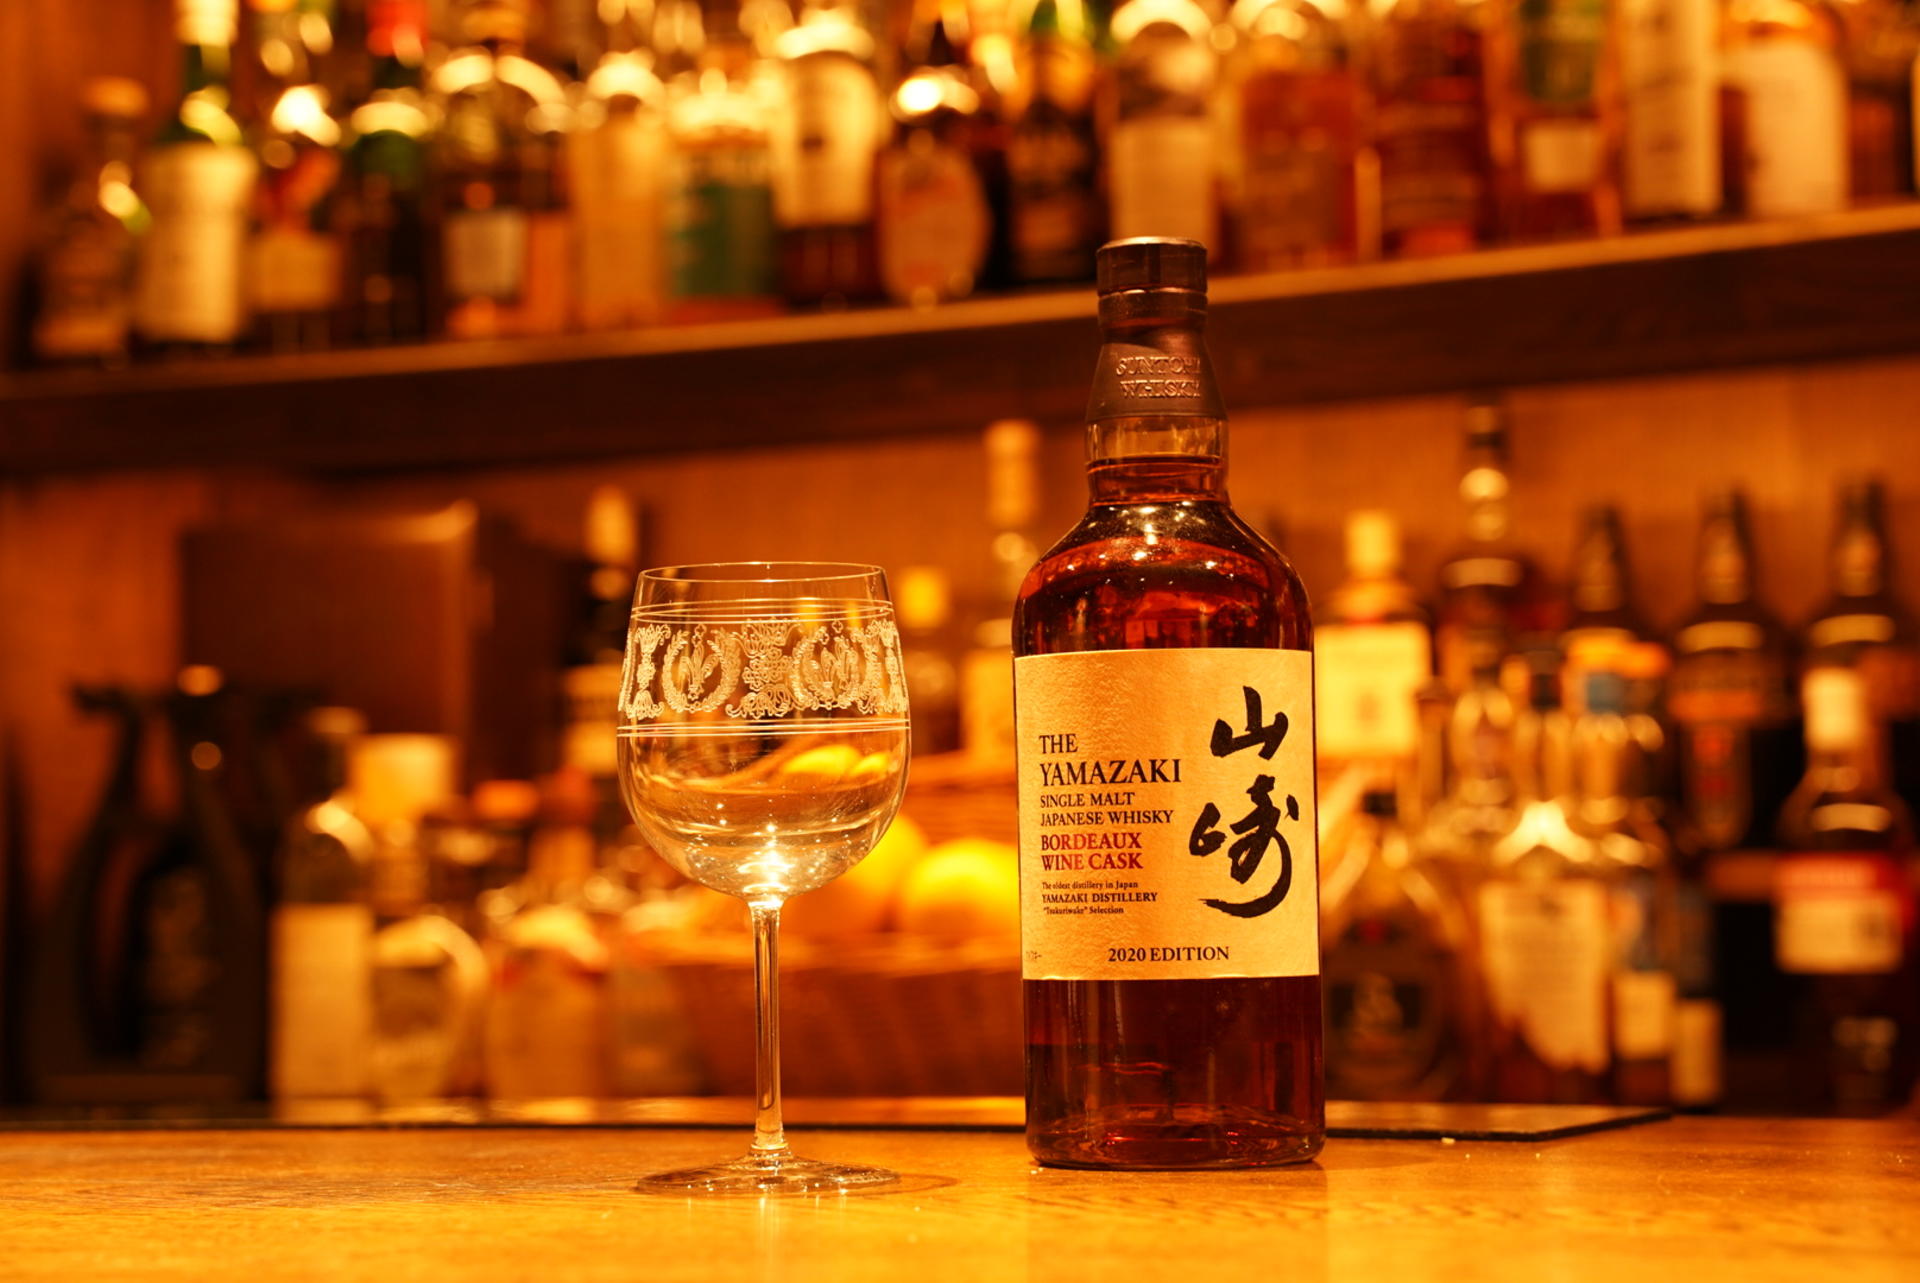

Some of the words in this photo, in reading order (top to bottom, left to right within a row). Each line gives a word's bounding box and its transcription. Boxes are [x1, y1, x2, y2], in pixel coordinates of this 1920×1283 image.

[1039, 733, 1078, 754] THE
[1040, 758, 1182, 787] YAMAZAKI
[1040, 793, 1085, 808] SINGLE
[1090, 792, 1136, 807] MALT
[1189, 685, 1299, 918] 山崎
[1040, 812, 1104, 827] JAPANESE
[1107, 810, 1174, 824] WHISKY
[1041, 832, 1143, 851] BORDEAUX
[1041, 854, 1085, 871] WINE
[1088, 852, 1144, 870] CASK
[1042, 881, 1052, 890] The
[1052, 881, 1071, 890] oldest
[1072, 880, 1104, 891] distillery
[1105, 880, 1114, 889] in
[1115, 880, 1138, 891] Japan
[1042, 893, 1089, 904] YAMAZAKI
[1091, 892, 1158, 904] DISTILLERY
[1089, 905, 1124, 914] Selection
[1107, 947, 1147, 963] 2020
[1149, 946, 1229, 962] EDITION
